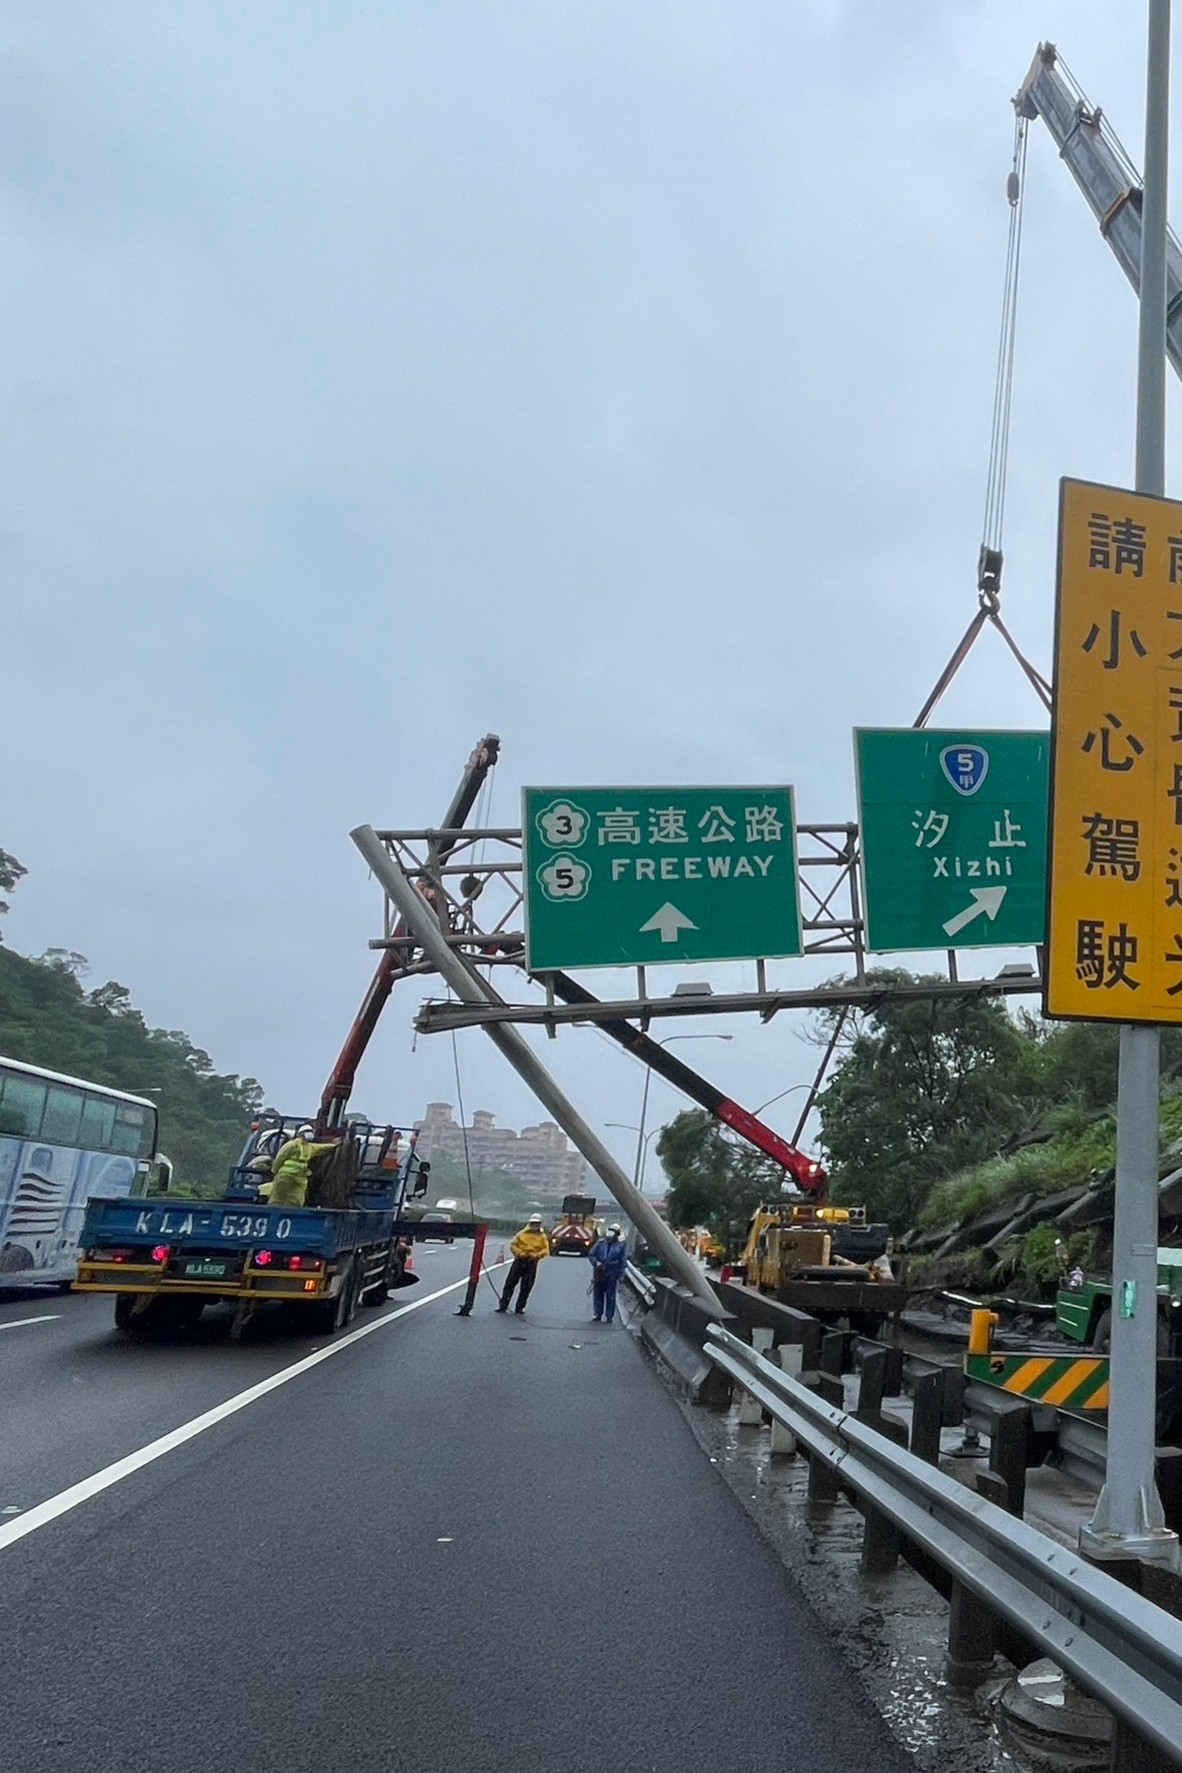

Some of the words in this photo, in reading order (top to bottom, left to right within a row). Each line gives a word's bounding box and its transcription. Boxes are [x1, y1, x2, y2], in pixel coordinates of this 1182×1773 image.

[1075, 513, 1148, 990] 請小心駕駛
[957, 753, 975, 772] 5
[959, 774, 974, 789] 甲
[555, 815, 573, 836] 3
[596, 804, 784, 847] 高速公路
[911, 809, 1027, 848] 汐止
[611, 854, 775, 881] FREEWAY
[933, 856, 1013, 877] Xizhi
[555, 868, 575, 889] 5
